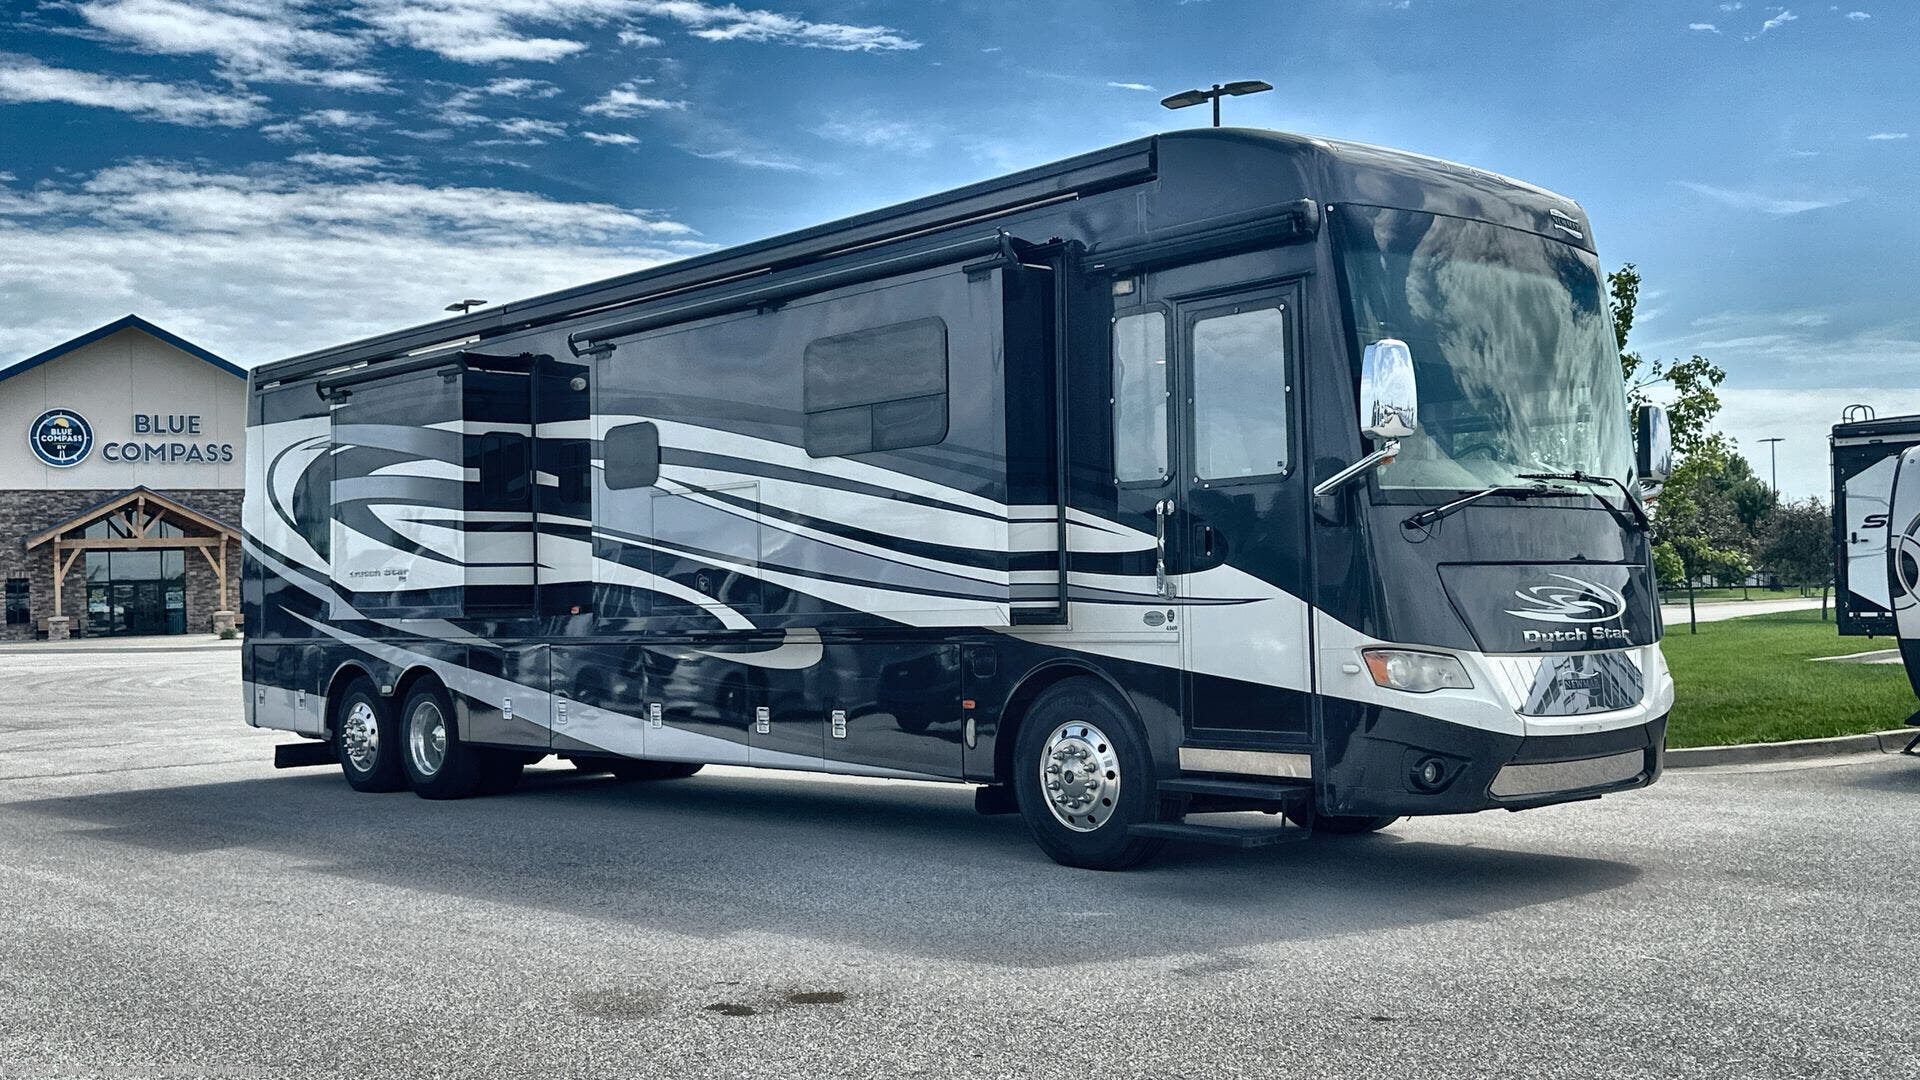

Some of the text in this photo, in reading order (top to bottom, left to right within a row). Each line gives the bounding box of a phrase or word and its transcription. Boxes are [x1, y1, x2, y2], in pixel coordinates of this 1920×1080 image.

[135, 414, 201, 434] BLUE
[103, 442, 234, 462] COMPASS
[383, 568, 409, 577] Star
[1523, 626, 1630, 643] Dutch Star
